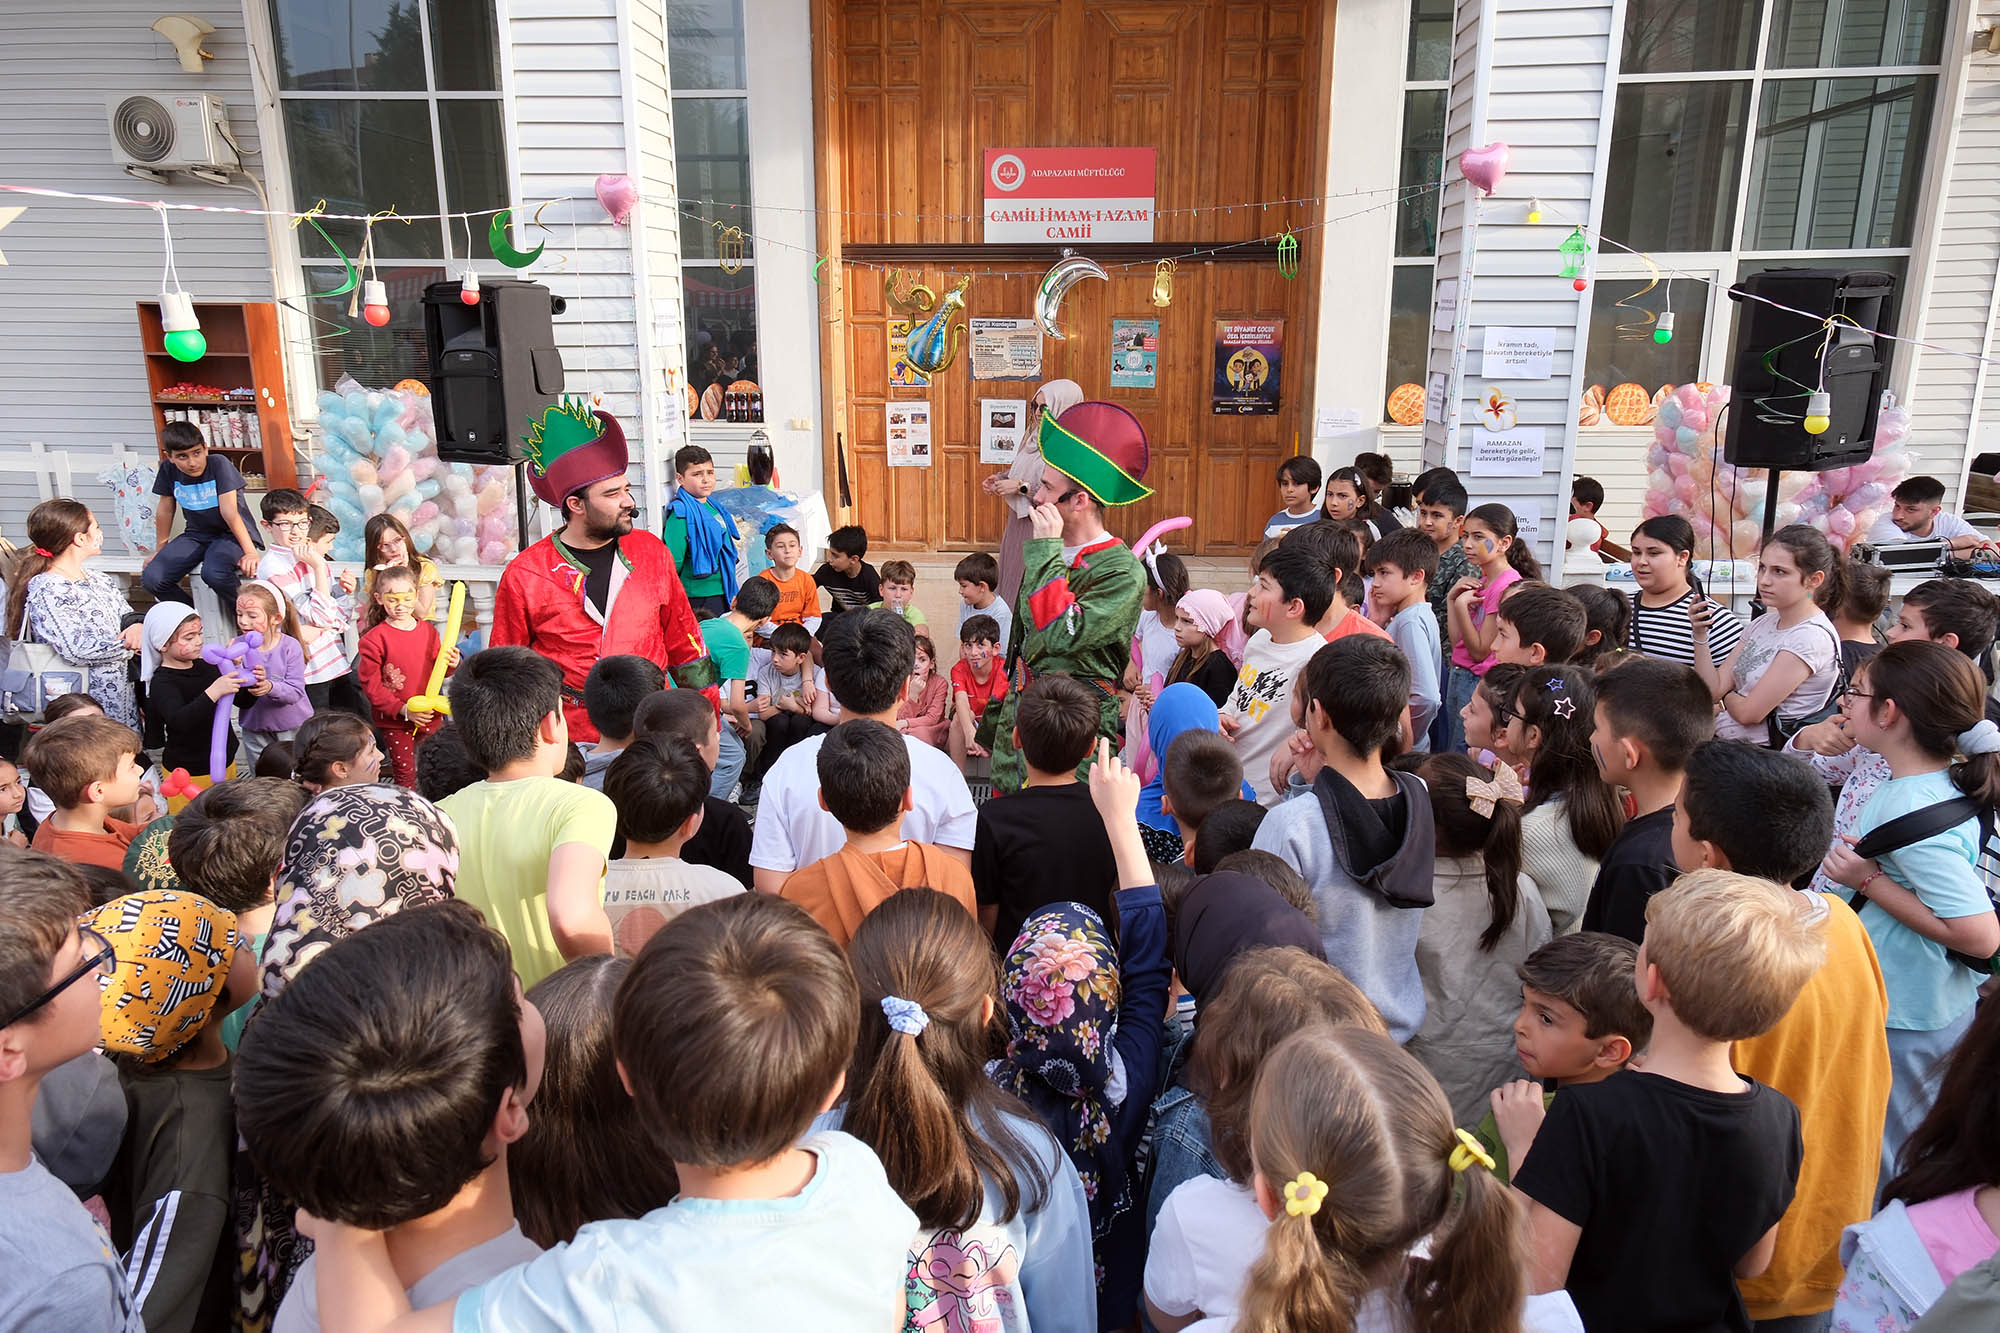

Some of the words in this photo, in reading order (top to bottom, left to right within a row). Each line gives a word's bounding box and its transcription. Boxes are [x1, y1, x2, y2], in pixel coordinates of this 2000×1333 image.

[1031, 169, 1076, 177] ADAPAZARI
[1077, 168, 1126, 177] MÜFTÜLÜĞÜ
[990, 208, 1044, 222] CAMİLİ
[1104, 209, 1148, 222] AZAM
[1046, 224, 1092, 239] CAMİİ
[625, 888, 656, 901] BEACH
[663, 887, 690, 901] PARK
